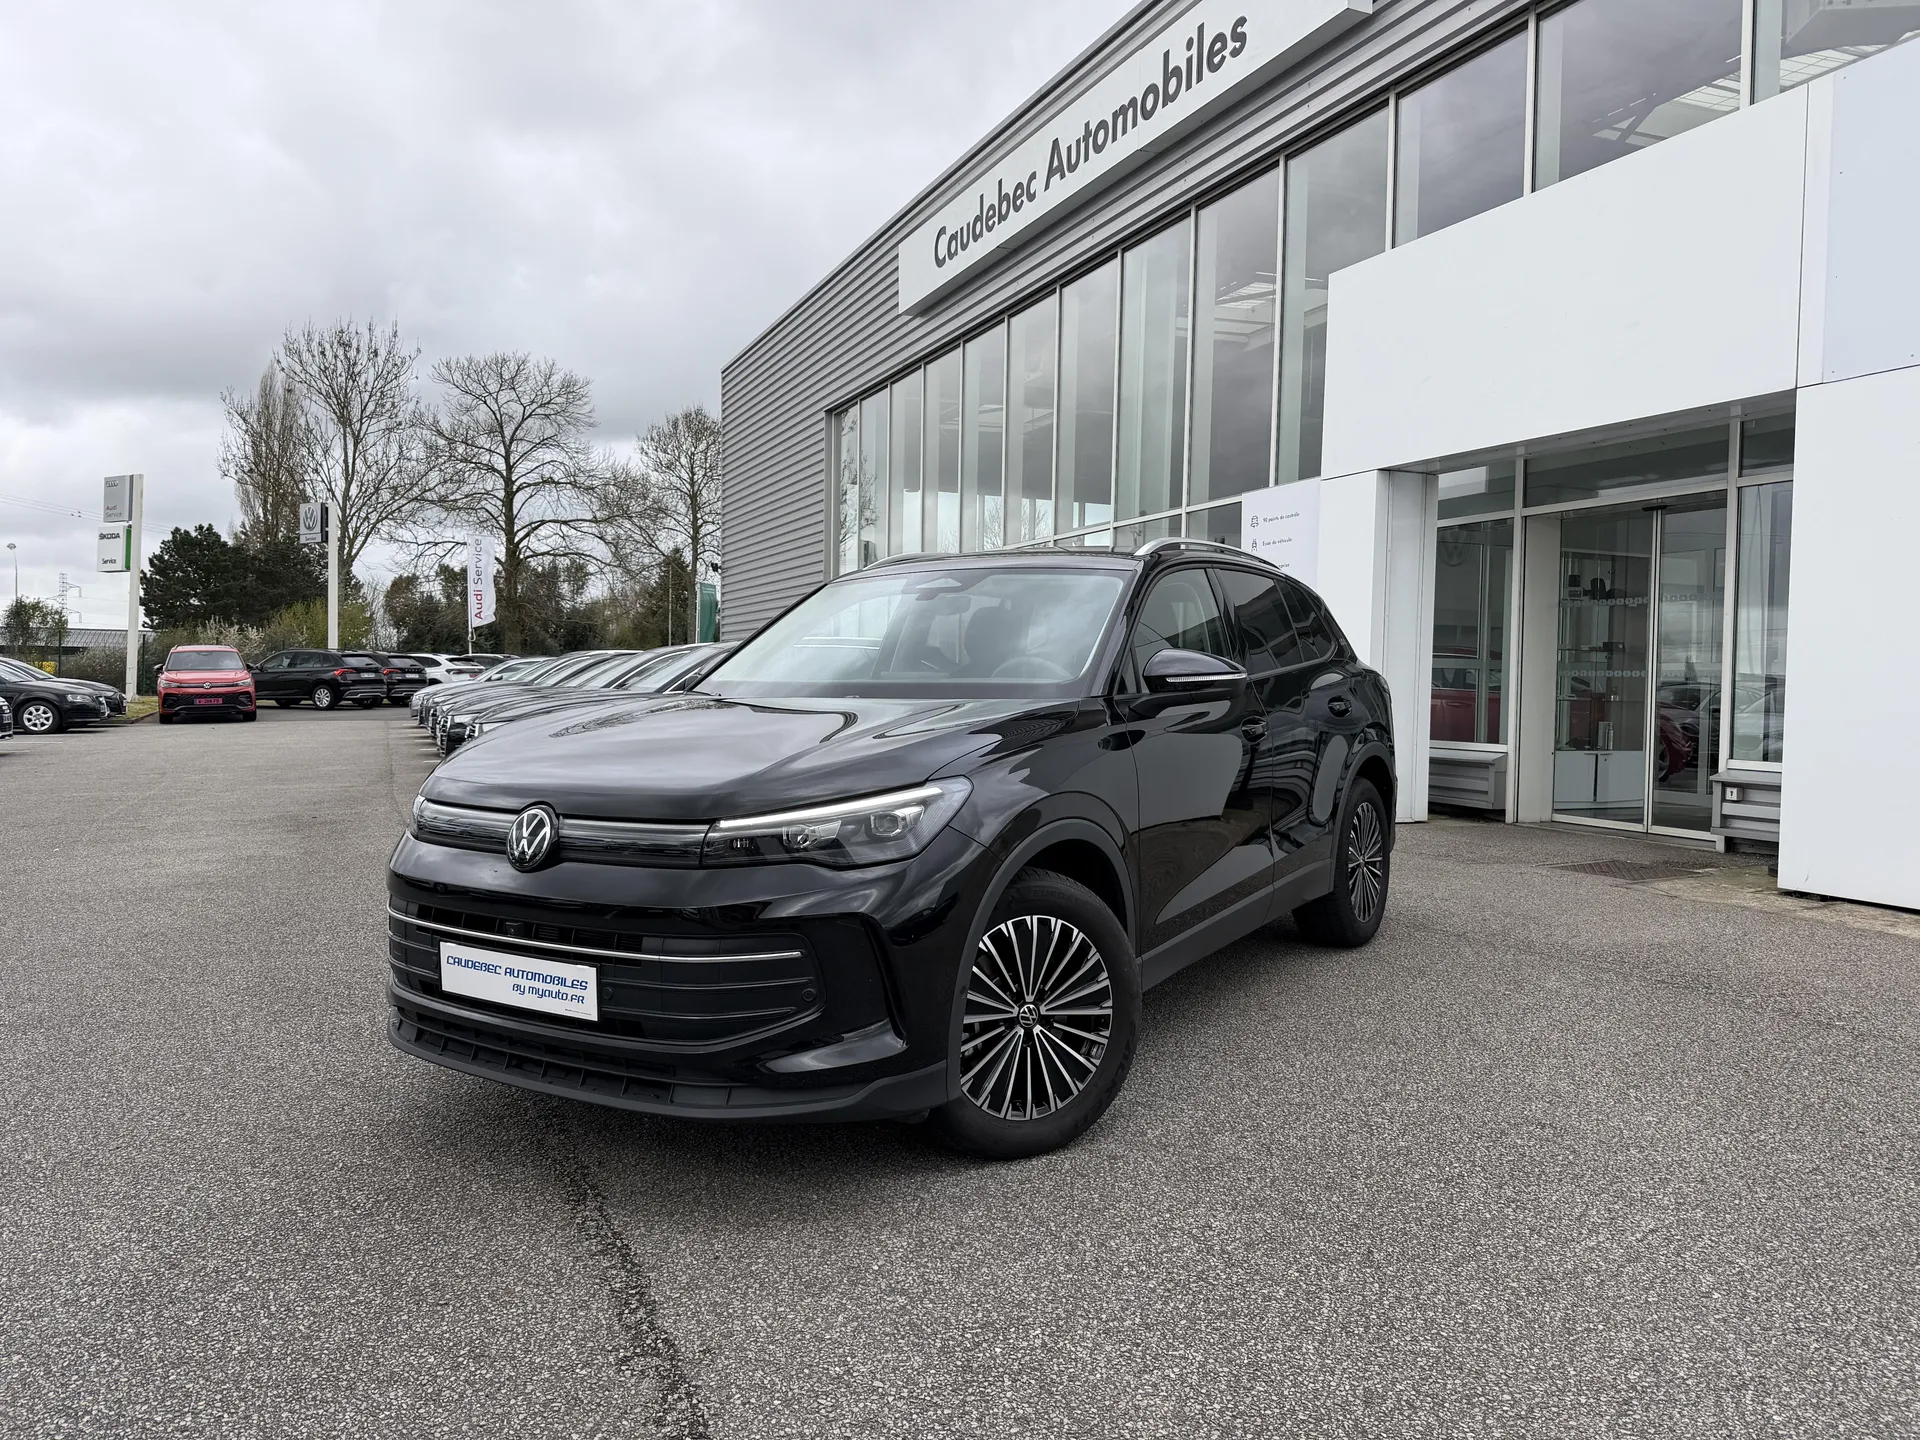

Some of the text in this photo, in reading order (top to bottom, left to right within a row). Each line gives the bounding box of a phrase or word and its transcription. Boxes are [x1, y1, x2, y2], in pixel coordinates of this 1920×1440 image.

[934, 15, 1248, 268] Caudebec Automobiles
[473, 538, 483, 620] Audi Service
[446, 955, 589, 991] CAUDEBEC AUTOMOBILES
